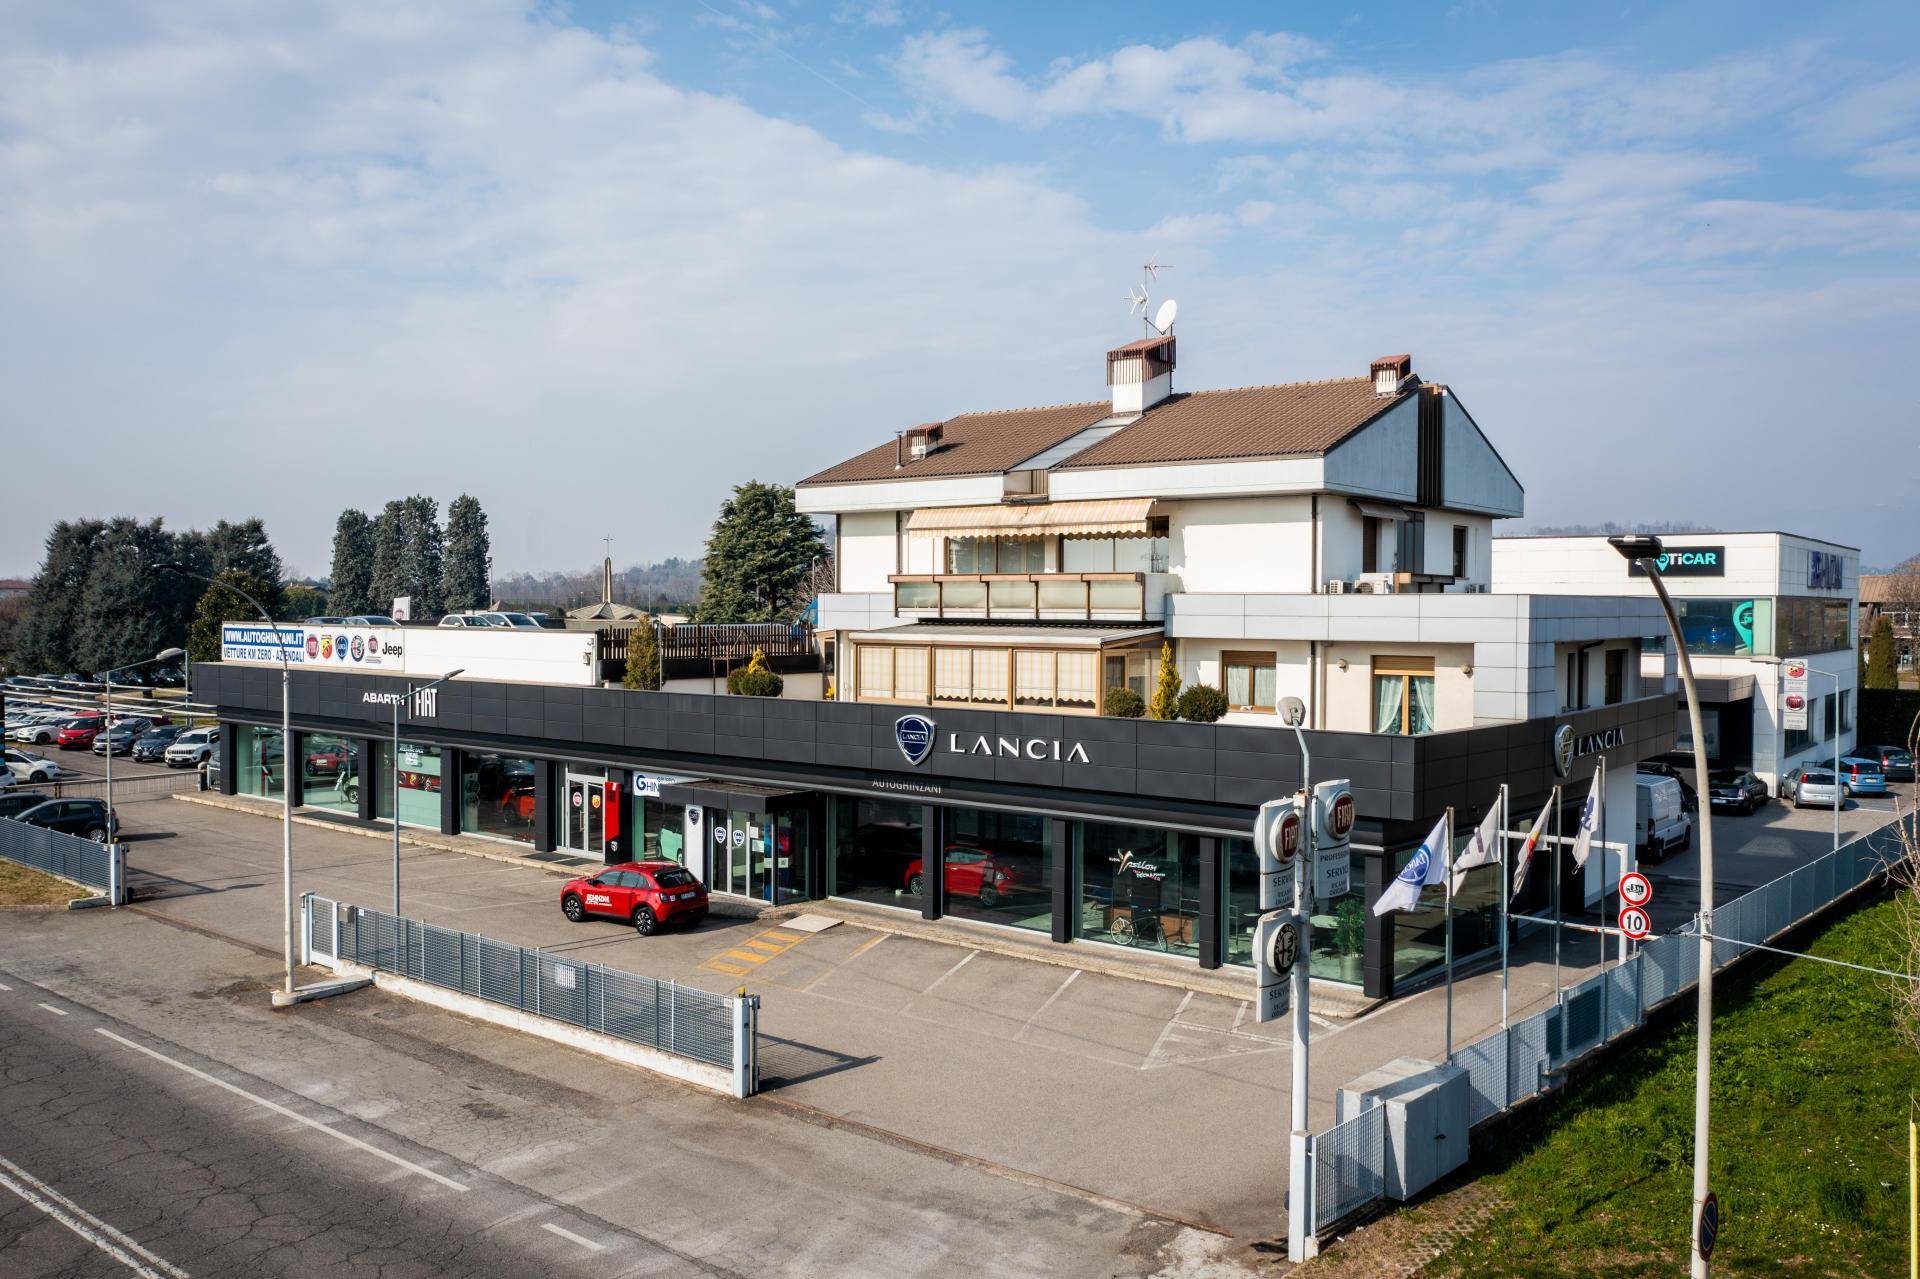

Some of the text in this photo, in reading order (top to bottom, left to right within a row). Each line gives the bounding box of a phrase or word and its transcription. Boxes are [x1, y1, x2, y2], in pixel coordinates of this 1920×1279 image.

[1635, 552, 1717, 572] OTiCAR
[224, 647, 247, 658] VETTURE
[247, 648, 256, 659] KM
[257, 649, 272, 661] ZERO
[275, 649, 305, 663] AZENDALI
[382, 642, 403, 658] Jeep
[415, 687, 438, 718] FIAT
[901, 732, 925, 742] LANCIA
[1578, 728, 1625, 757] LANCIA
[950, 733, 1090, 764] LANCIA
[636, 774, 660, 793] GHIN
[872, 778, 942, 794] AUTOGHINZANI
[1337, 803, 1353, 828] FIAT
[1284, 824, 1299, 852] FIAT
[1626, 913, 1643, 931] 10
